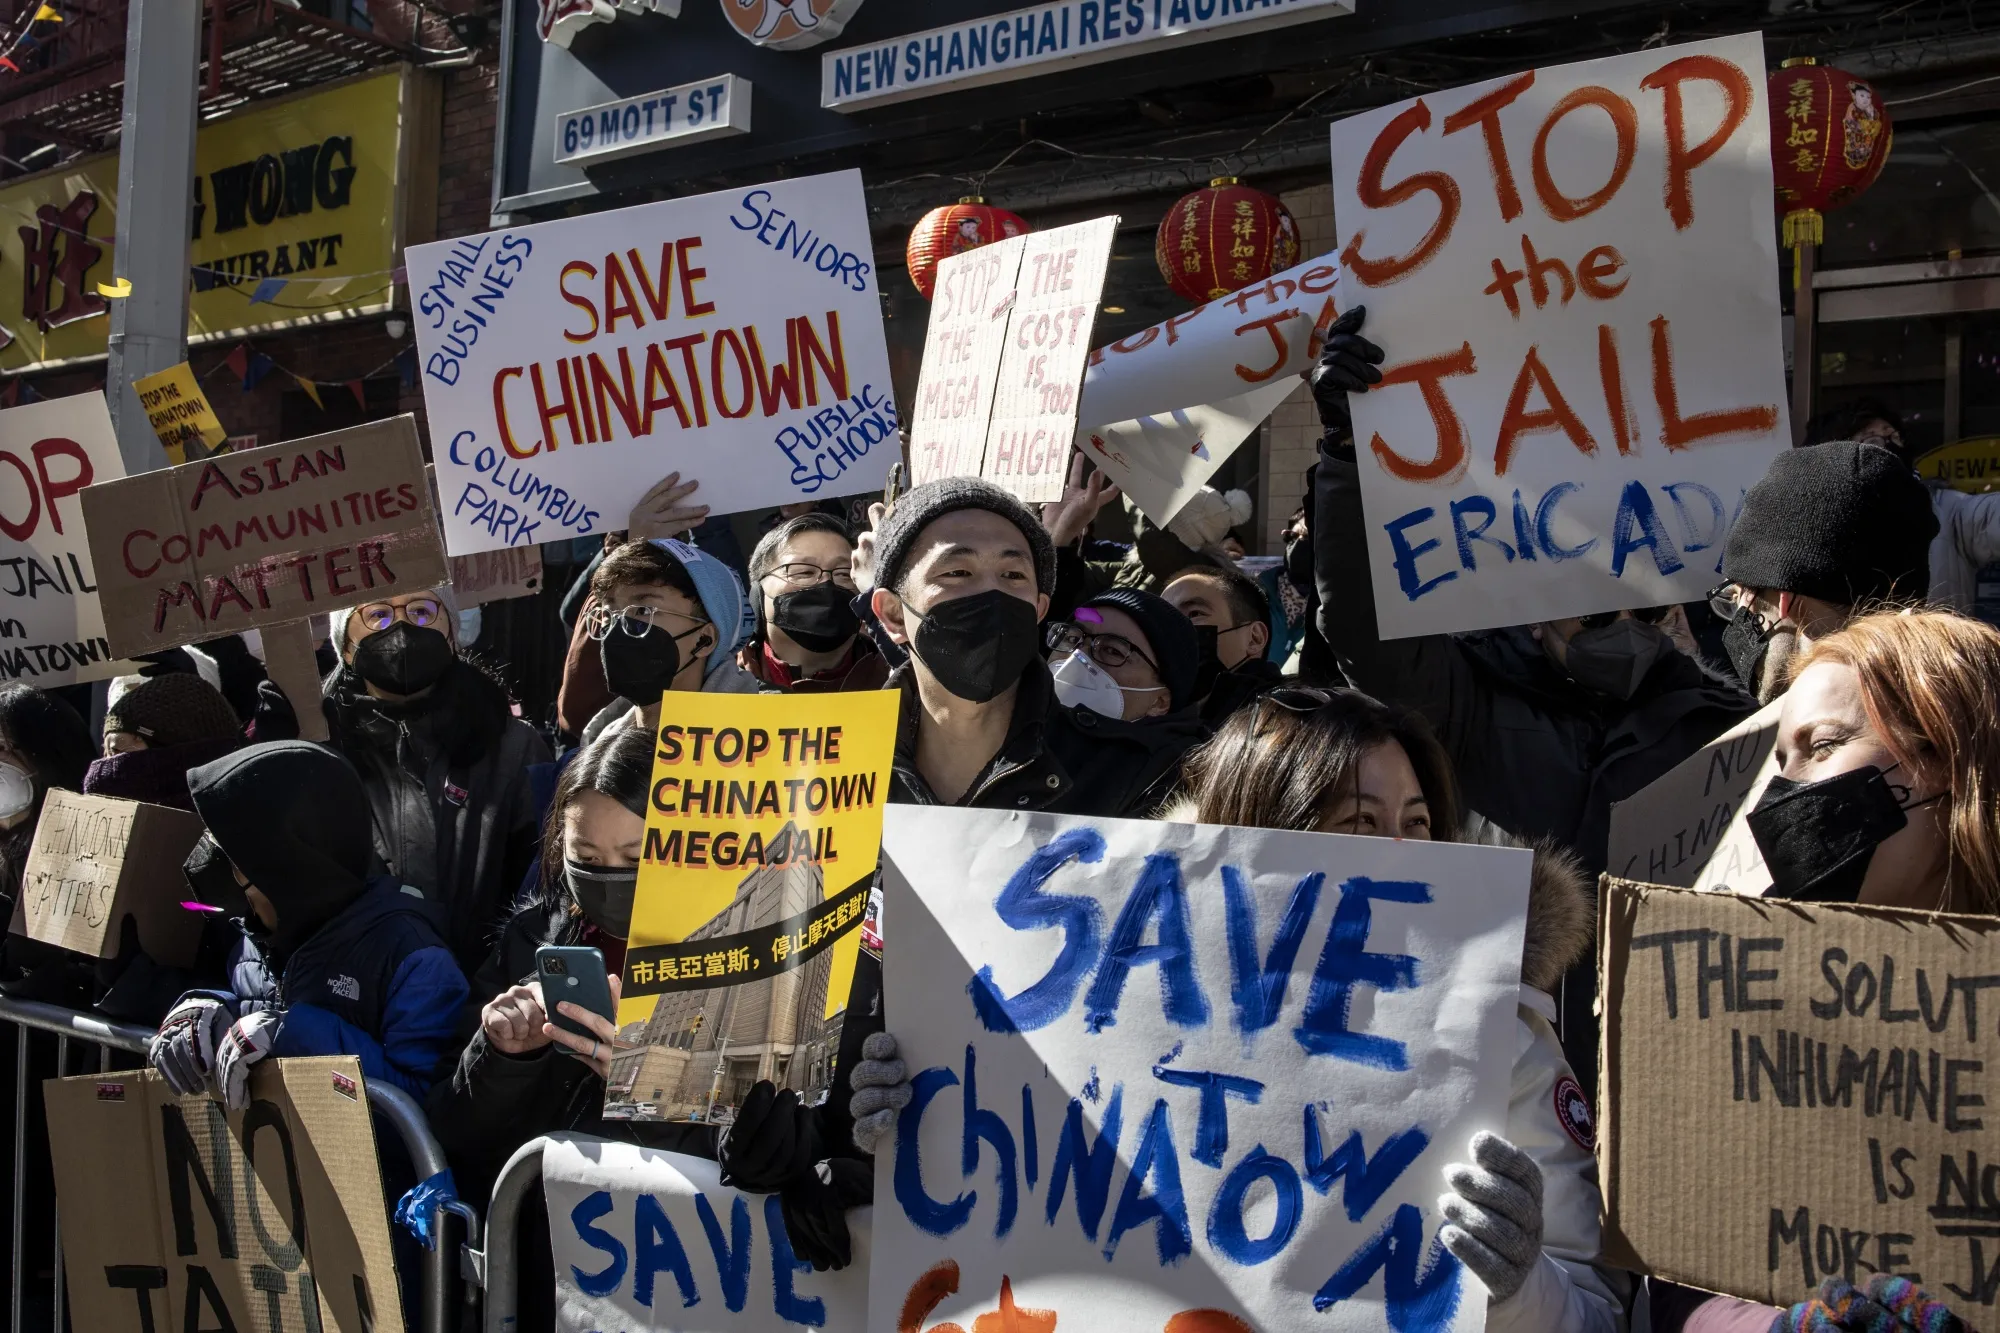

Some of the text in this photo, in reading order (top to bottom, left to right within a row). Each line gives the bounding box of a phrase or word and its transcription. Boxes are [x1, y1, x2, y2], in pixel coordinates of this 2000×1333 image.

[834, 45, 899, 98] NEW
[904, 9, 1070, 82] SHANGHAI
[564, 84, 724, 153] 69 MOTT ST
[1784, 78, 1818, 173] 吉祥如意
[211, 136, 356, 233] WONG
[1340, 55, 1754, 288] STOP
[730, 190, 870, 292] SENIORS
[1031, 249, 1078, 298] THE
[1229, 200, 1257, 281] 吉祥如意
[1484, 233, 1632, 321] the
[419, 236, 491, 329] SMALL
[426, 234, 533, 386] BUSINESS
[559, 235, 716, 344] SAVE
[939, 254, 1001, 323] STOP
[938, 326, 976, 367] THE
[1017, 305, 1086, 351] COST
[140, 382, 182, 410] STOP THE
[492, 310, 851, 461] CHINATOWN
[922, 374, 980, 422] MEGA
[1024, 354, 1048, 389] IS
[1039, 382, 1075, 416] TOO
[1368, 313, 1779, 487] JAIL
[148, 397, 206, 430] CHINATOWN
[774, 384, 886, 467] PUBLIC
[790, 400, 899, 493] SCHOOLS
[995, 428, 1067, 477] HIGH
[190, 445, 346, 511] ASIAN
[449, 430, 600, 534] COLUMBUS
[1937, 457, 1986, 479] NEW
[122, 483, 418, 579] COMMUNITIES
[454, 483, 541, 546] PARK
[1383, 482, 1600, 601] ERIC
[3, 551, 98, 600] JAIL
[153, 540, 397, 633] MATTER
[657, 725, 843, 765] STOP THE
[1703, 722, 1762, 797] NO
[651, 771, 876, 818] CHINATOWN
[643, 825, 838, 868] MEGA JAIL
[16, 871, 112, 929] MATTERS
[327, 978, 351, 991] NORTH
[339, 974, 353, 984] THE
[966, 828, 1434, 1073] SAVE
[1631, 928, 2000, 1043] THE SOLUT
[332, 986, 351, 998] FACE
[1731, 1028, 1986, 1133] INHUMANE
[161, 1101, 304, 1272] NO
[1868, 1137, 1917, 1204] IS
[570, 1191, 826, 1327] SAVE
[1768, 1206, 1922, 1291] MORE
